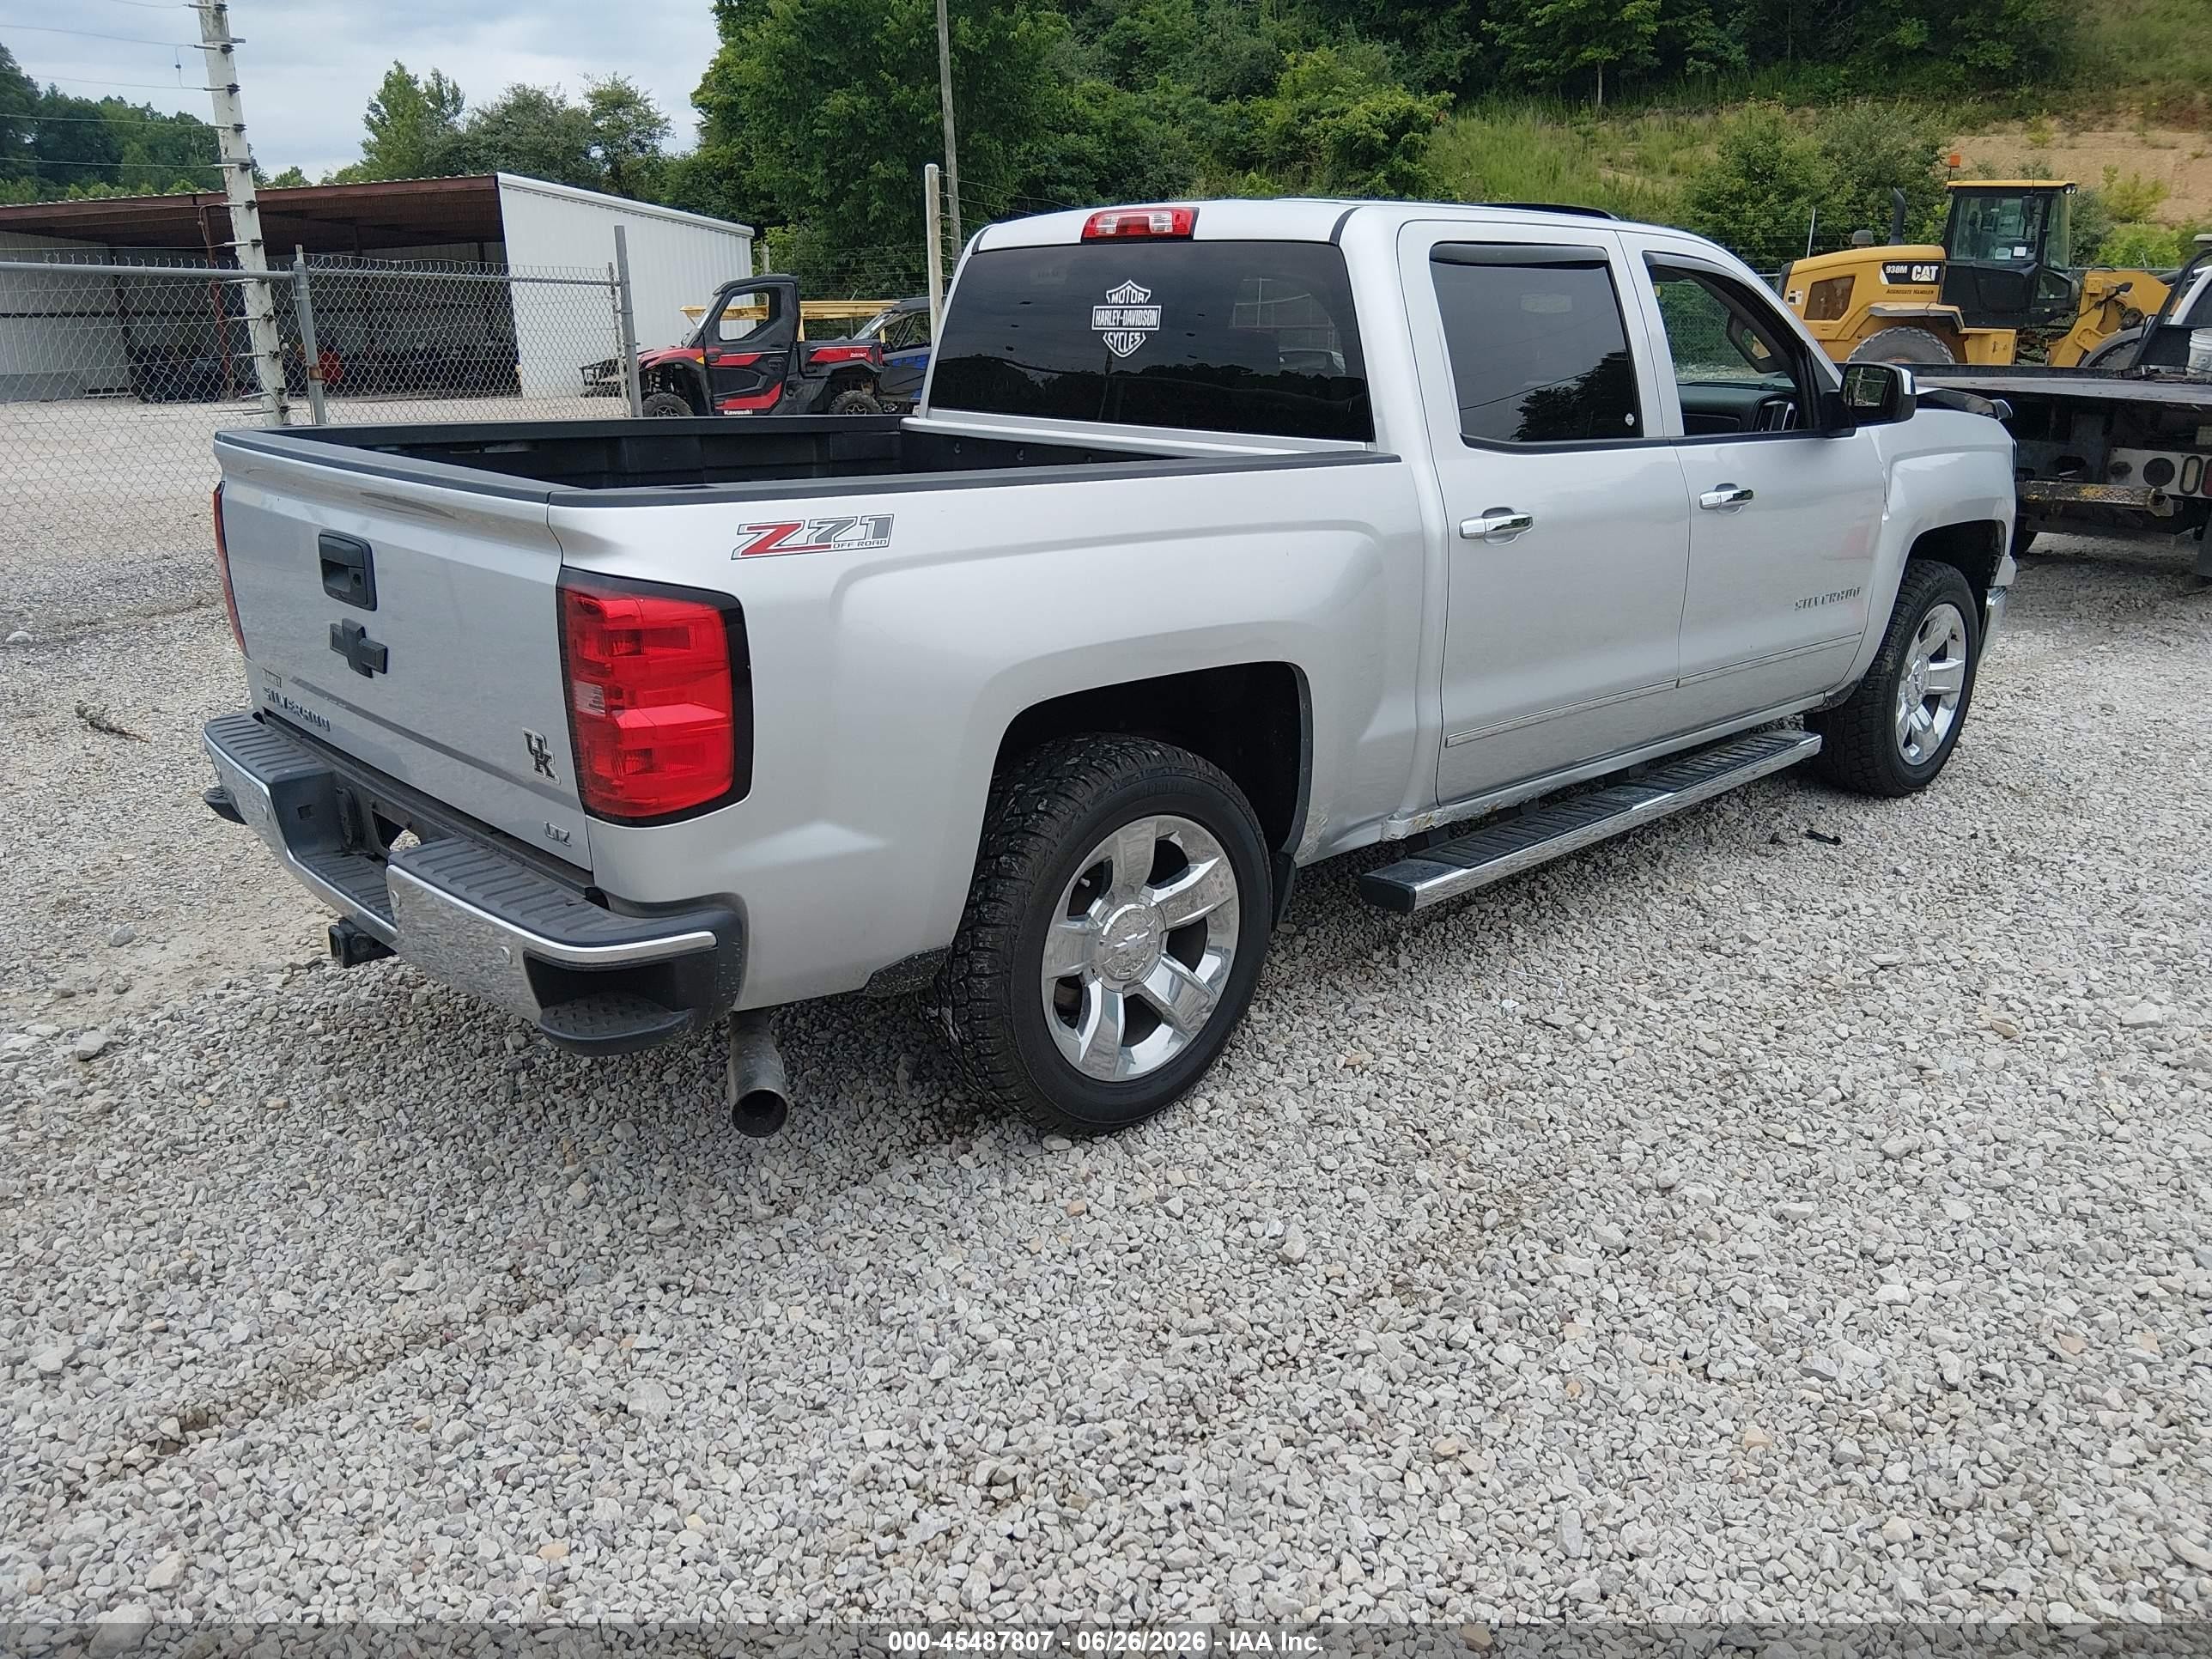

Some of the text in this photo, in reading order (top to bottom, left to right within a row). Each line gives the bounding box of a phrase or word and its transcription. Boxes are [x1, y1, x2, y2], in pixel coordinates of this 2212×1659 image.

[1886, 265, 1939, 282] 938M CAT
[1111, 285, 1145, 304] MOTOR
[1095, 309, 1158, 326] HARLEY-DAVIDSON
[1107, 331, 1141, 353] CYCLES
[731, 513, 894, 560] Z71
[857, 538, 887, 547] ROAD
[522, 727, 562, 785] UK
